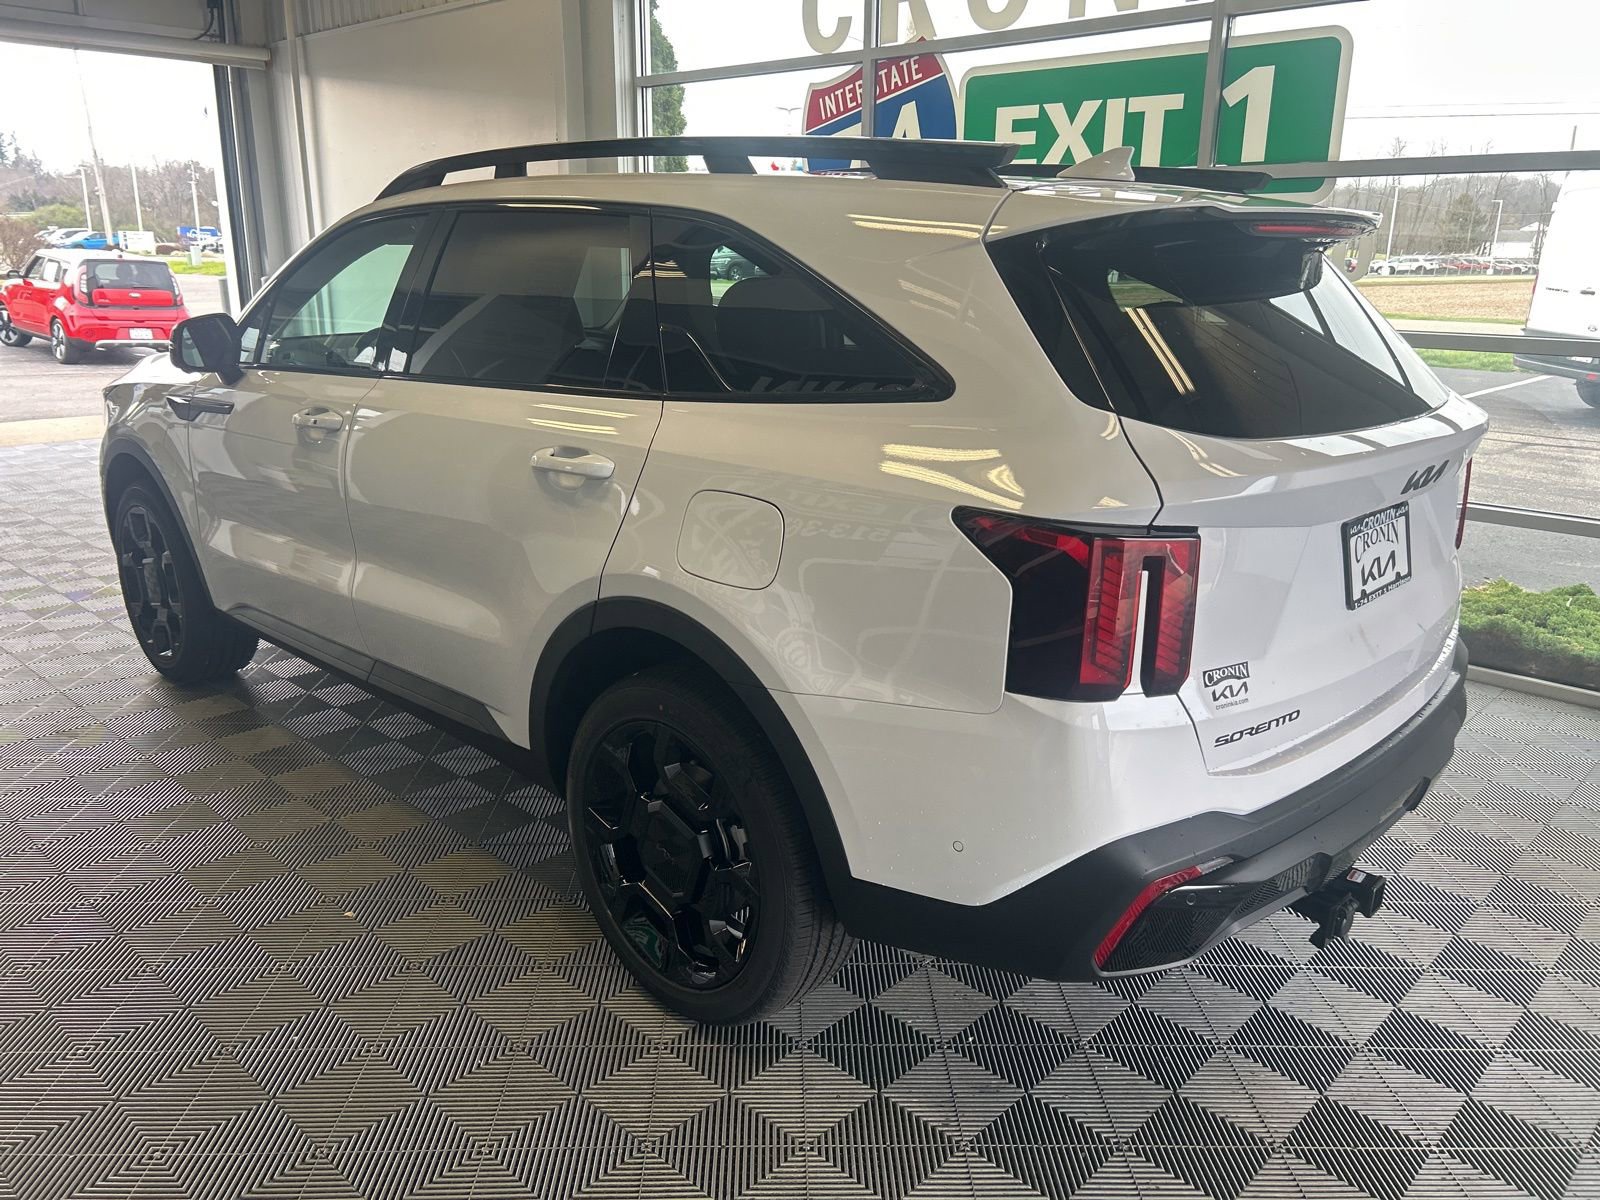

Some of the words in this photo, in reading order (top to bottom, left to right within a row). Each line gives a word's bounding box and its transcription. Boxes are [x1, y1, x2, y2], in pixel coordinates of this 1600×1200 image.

[819, 56, 923, 120] INTERTATE
[995, 93, 1185, 168] EXIT
[1222, 65, 1275, 163] 1
[1400, 459, 1449, 495] KIA
[1361, 508, 1397, 531] CRONIN
[1354, 518, 1400, 563] CRONIN
[1361, 550, 1396, 586] KIA
[1204, 662, 1249, 686] CRONIN
[1211, 681, 1249, 702] KIA
[1213, 709, 1301, 748] SORENTO
